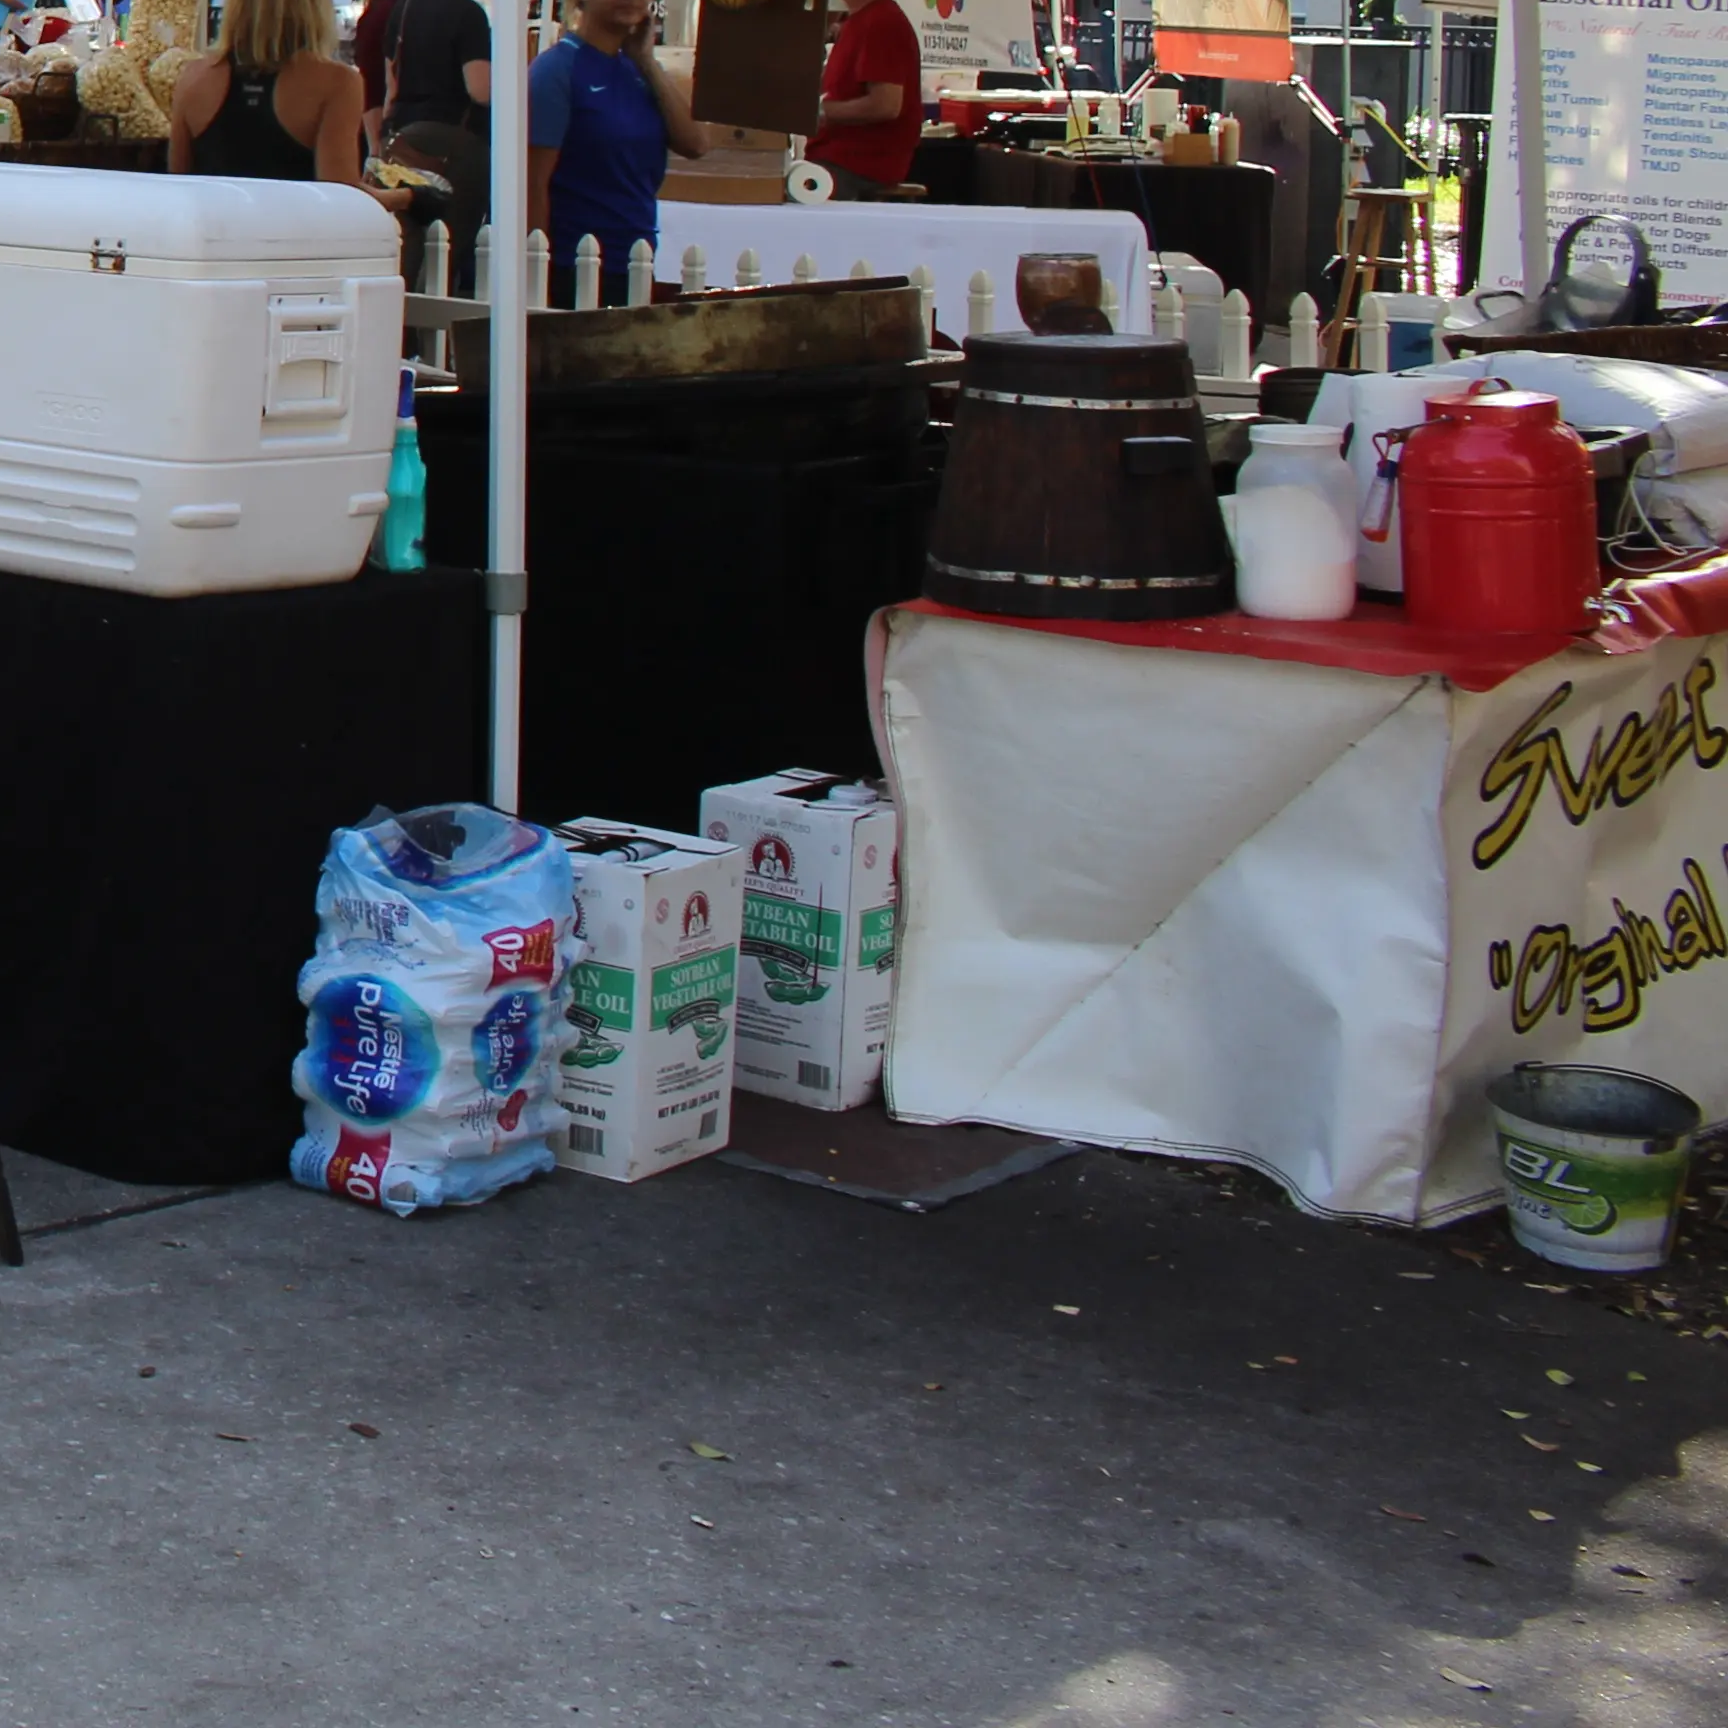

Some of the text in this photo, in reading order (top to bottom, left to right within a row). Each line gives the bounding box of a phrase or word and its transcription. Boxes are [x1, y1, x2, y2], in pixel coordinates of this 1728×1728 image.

[1580, 19, 1644, 37] Natural
[1657, 22, 1702, 40] Fast
[1646, 68, 1717, 84] Migraines
[1561, 93, 1610, 107] Tunnel
[1643, 98, 1696, 113] Plantar
[1645, 83, 1728, 101] Neuropathy
[1643, 114, 1705, 129] Restless
[1642, 129, 1714, 145] Tendinitis
[1641, 144, 1685, 158] Tense
[1641, 159, 1682, 174] TMJD
[1633, 193, 1659, 207] oils
[1662, 195, 1684, 209] for
[1545, 203, 1723, 228] motional Support Blends
[1649, 225, 1712, 244] for Dogs
[1473, 657, 1728, 870] Sweet
[766, 881, 805, 897] QUALITY
[743, 897, 810, 928] OYBEAN
[490, 932, 525, 974] 40
[804, 932, 837, 954] OIL
[670, 956, 721, 989] SOYBEAN
[653, 972, 733, 1011] VEGETABLE OIL
[595, 991, 630, 1015] OIL
[374, 1010, 403, 1091] Nestlé
[333, 1059, 373, 1116] Life
[345, 1152, 378, 1202] 40
[1505, 1142, 1593, 1194] BL
